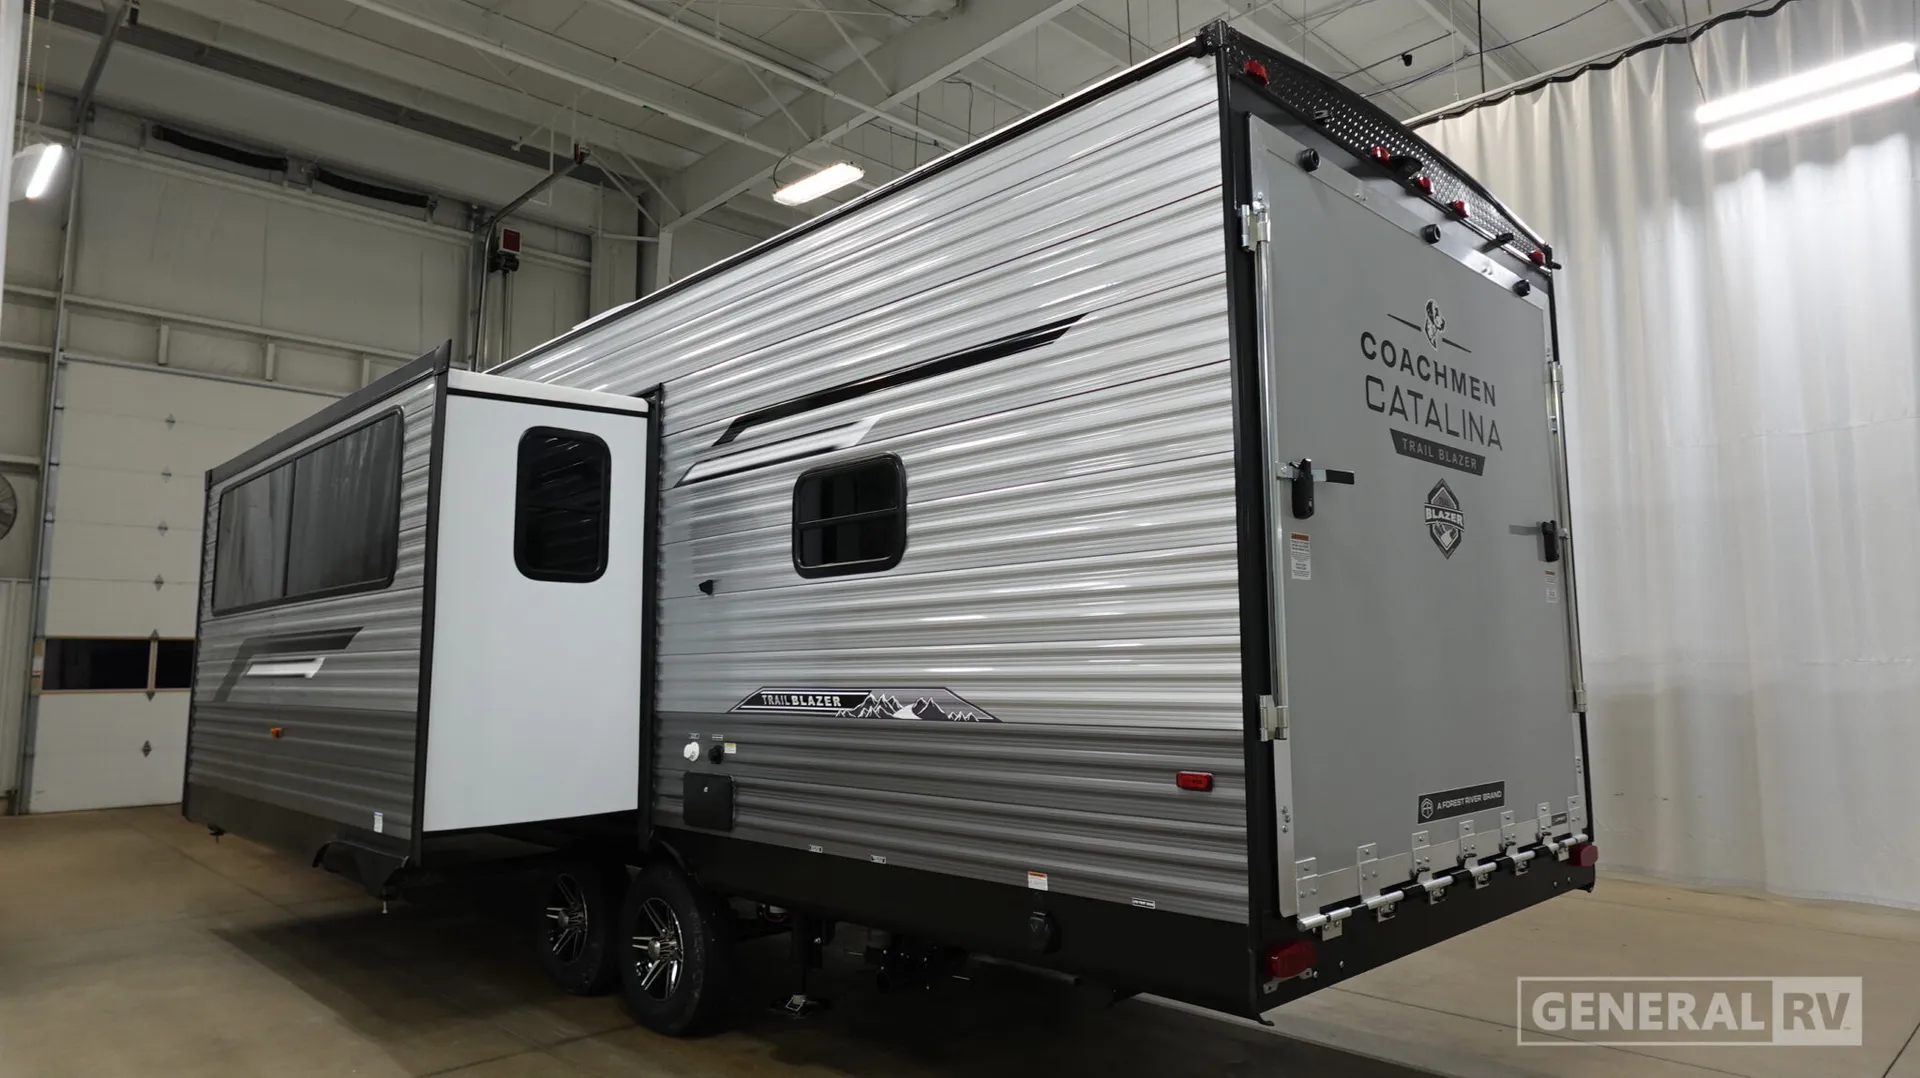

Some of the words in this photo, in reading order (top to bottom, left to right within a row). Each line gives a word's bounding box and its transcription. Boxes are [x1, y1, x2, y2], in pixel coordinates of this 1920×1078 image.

[1360, 331, 1496, 406] COACHMEN
[1365, 374, 1504, 451] CATALINA
[1402, 438, 1434, 458] TRAIL
[1439, 449, 1477, 470] BLAZER
[1425, 507, 1464, 526] BLAZER
[761, 694, 790, 706] TRAIL
[791, 695, 842, 707] BLAZER
[1436, 801, 1443, 810] A
[1442, 798, 1465, 808] FOREST
[1465, 795, 1482, 804] RIVER
[1482, 791, 1502, 801] BRAND
